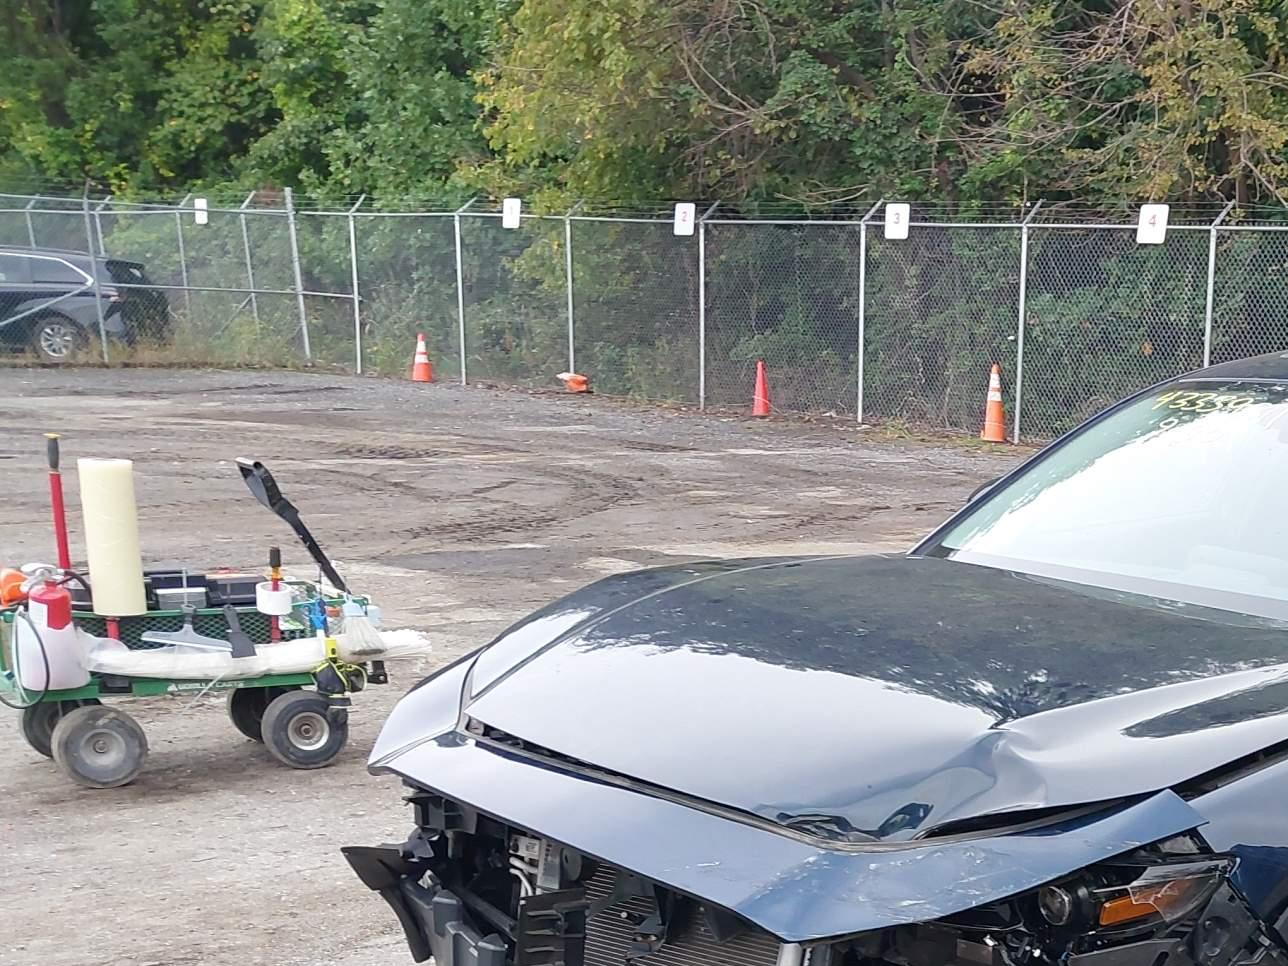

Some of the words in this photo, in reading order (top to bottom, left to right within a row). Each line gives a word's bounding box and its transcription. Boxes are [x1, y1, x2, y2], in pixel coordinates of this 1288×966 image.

[681, 210, 688, 222] 2
[893, 212, 900, 224] 3
[1148, 214, 1157, 227] 4
